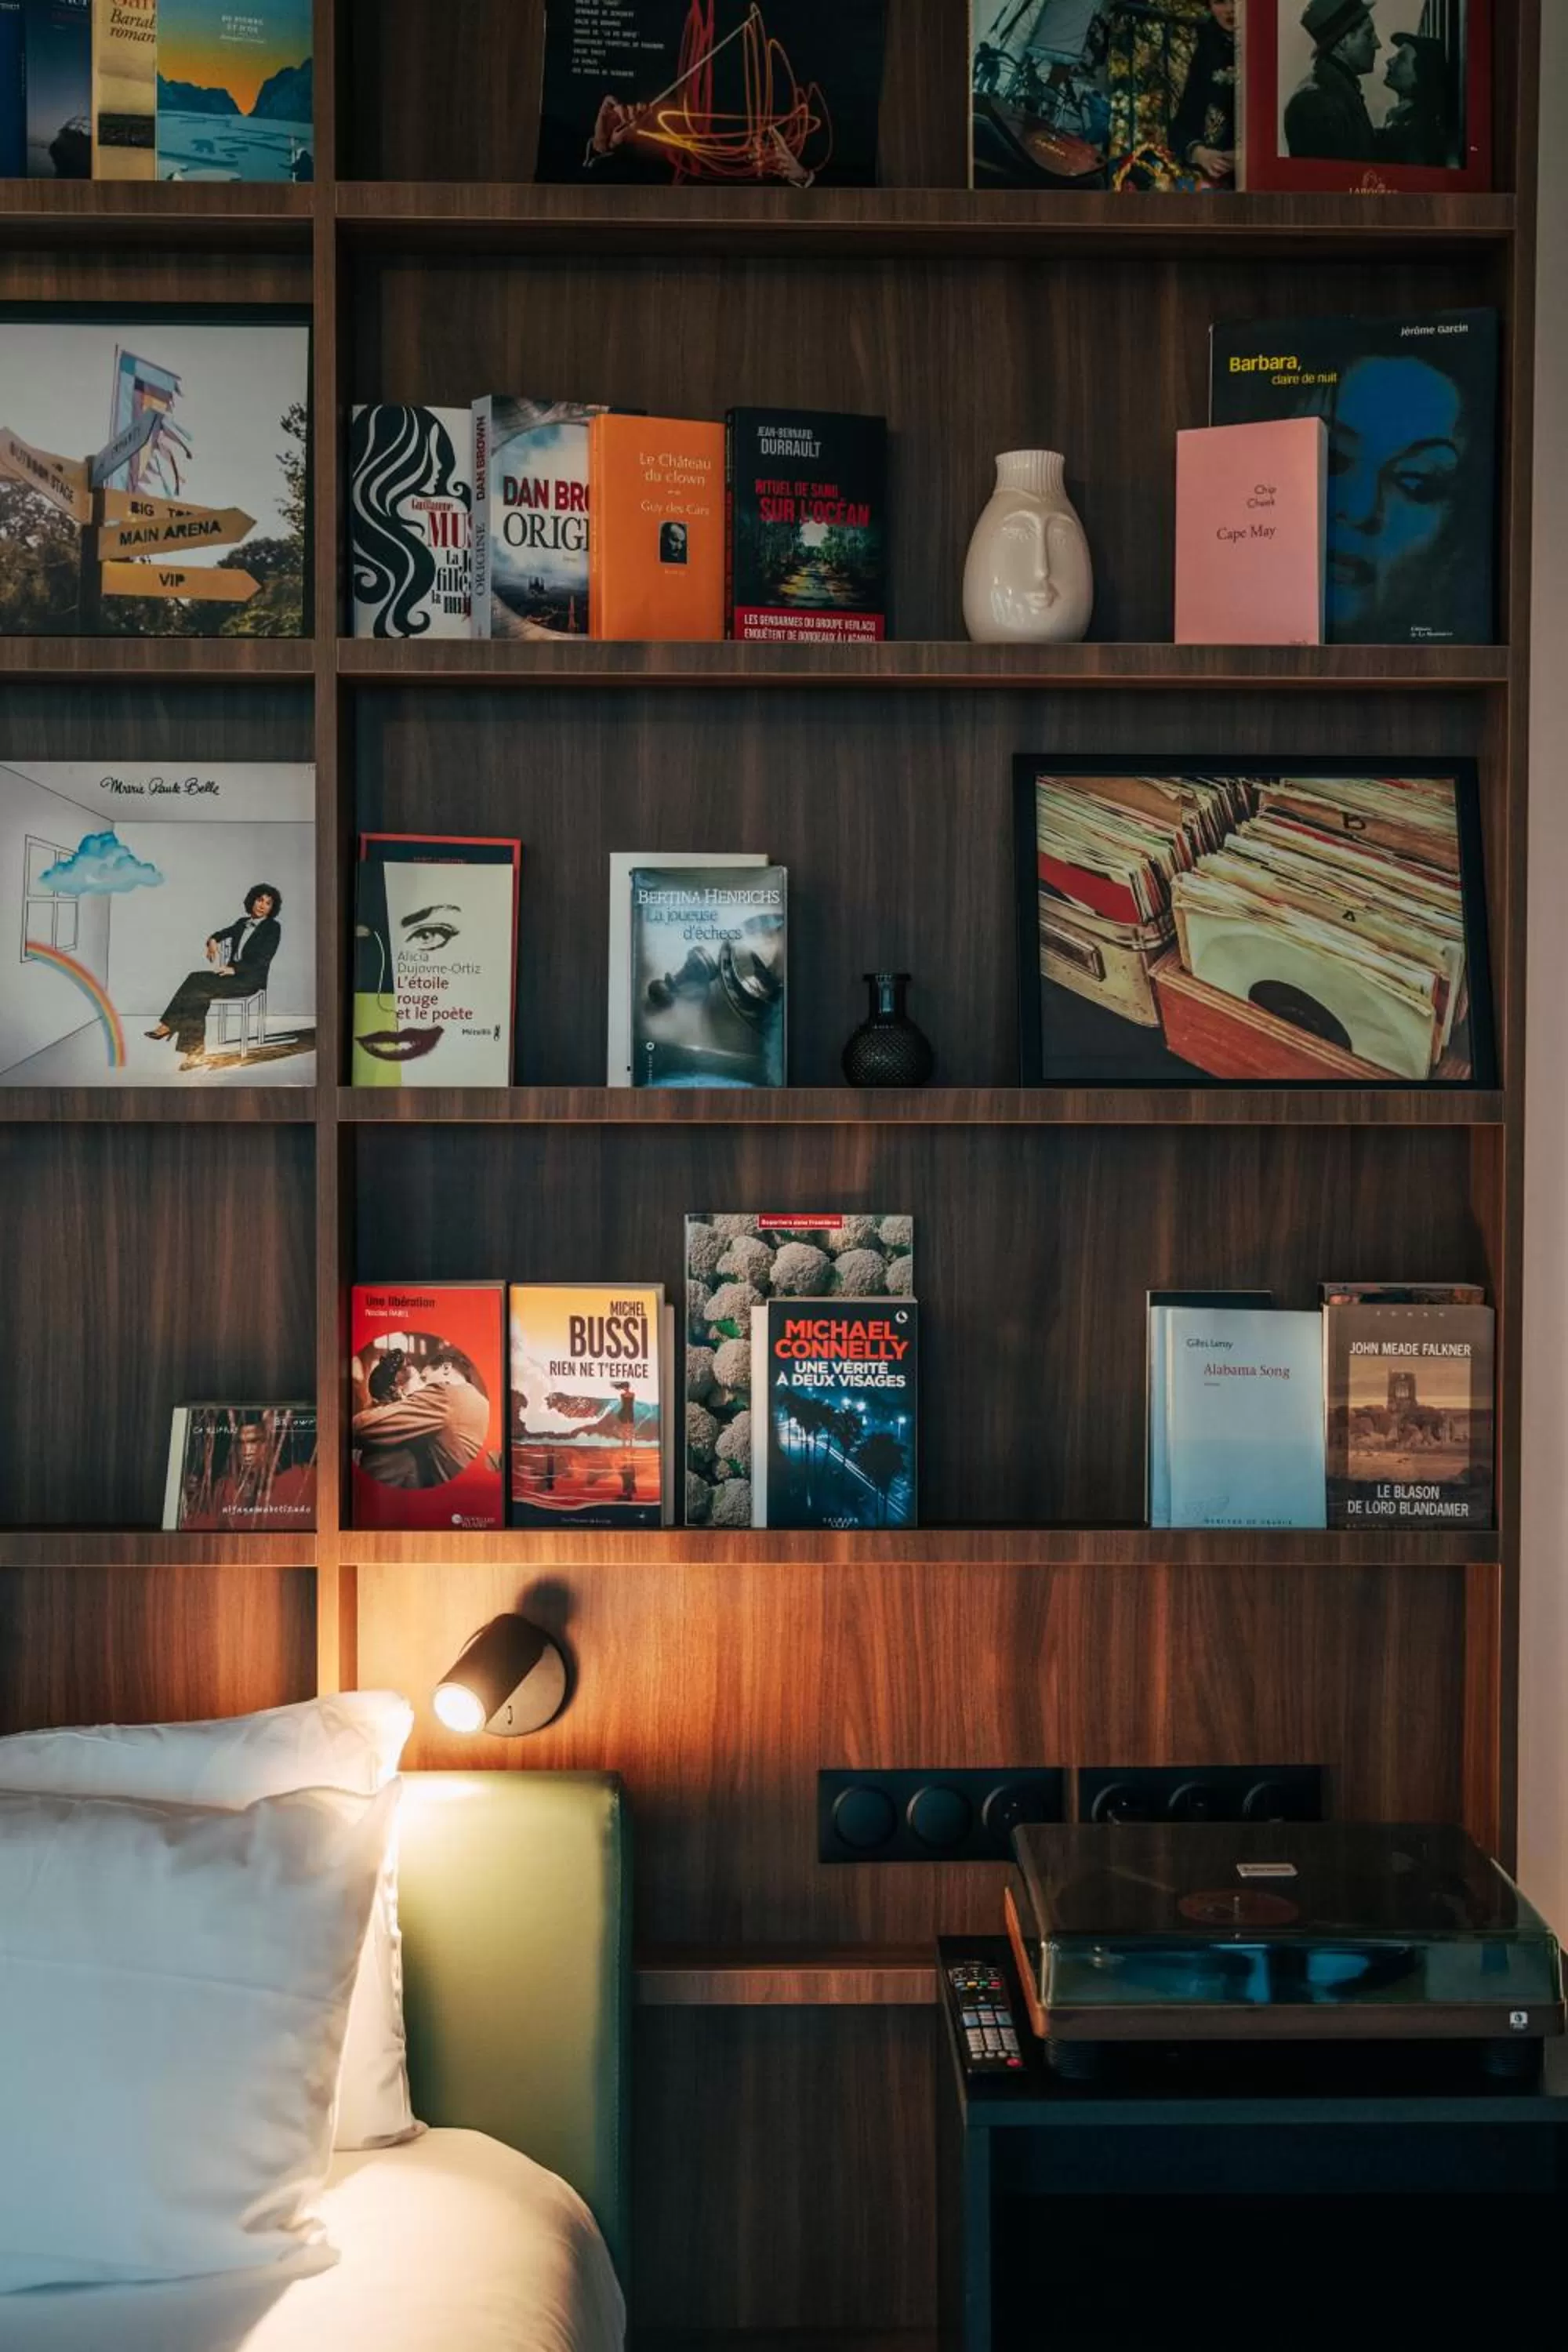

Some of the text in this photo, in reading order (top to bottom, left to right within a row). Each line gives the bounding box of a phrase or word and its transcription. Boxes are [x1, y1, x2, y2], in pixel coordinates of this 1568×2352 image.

[109, 26, 156, 44] roman
[1230, 354, 1301, 372] Barbara,
[1272, 372, 1338, 385] claire de nuit
[761, 437, 822, 458] DURRAULT
[639, 452, 712, 470] Le Château
[475, 470, 486, 502] DAN
[645, 468, 706, 488] du clown
[755, 478, 792, 496] RITUEL
[793, 481, 809, 496] DE
[503, 475, 550, 509] DAN
[130, 501, 154, 517] BIG
[760, 497, 870, 528] SUR L'OCÉAN
[120, 520, 222, 546] MAIN ARENA
[1217, 524, 1278, 543] Cape May
[159, 572, 185, 586] VIP
[744, 614, 758, 625] LES
[397, 976, 449, 989] L'étoile
[397, 995, 438, 1009] rouge
[396, 1007, 474, 1022] et le poète
[610, 1301, 647, 1317] MICHEL
[568, 1315, 649, 1359] BUSSI
[785, 1320, 898, 1341] MICHAEL
[774, 1341, 909, 1361] CONNELLY
[1349, 1341, 1472, 1357] JOHN MEADE FALKNER
[550, 1361, 649, 1379] RIEN NE T'EFFACE
[795, 1359, 888, 1375] UNE VÉRITÉ
[1204, 1363, 1291, 1381] Alabama Song
[792, 1374, 837, 1387] DEUX
[840, 1374, 906, 1389] VISAGES
[1377, 1485, 1441, 1500] LE BLASON
[1348, 1501, 1469, 1518] DE LORD BLANDAMER
